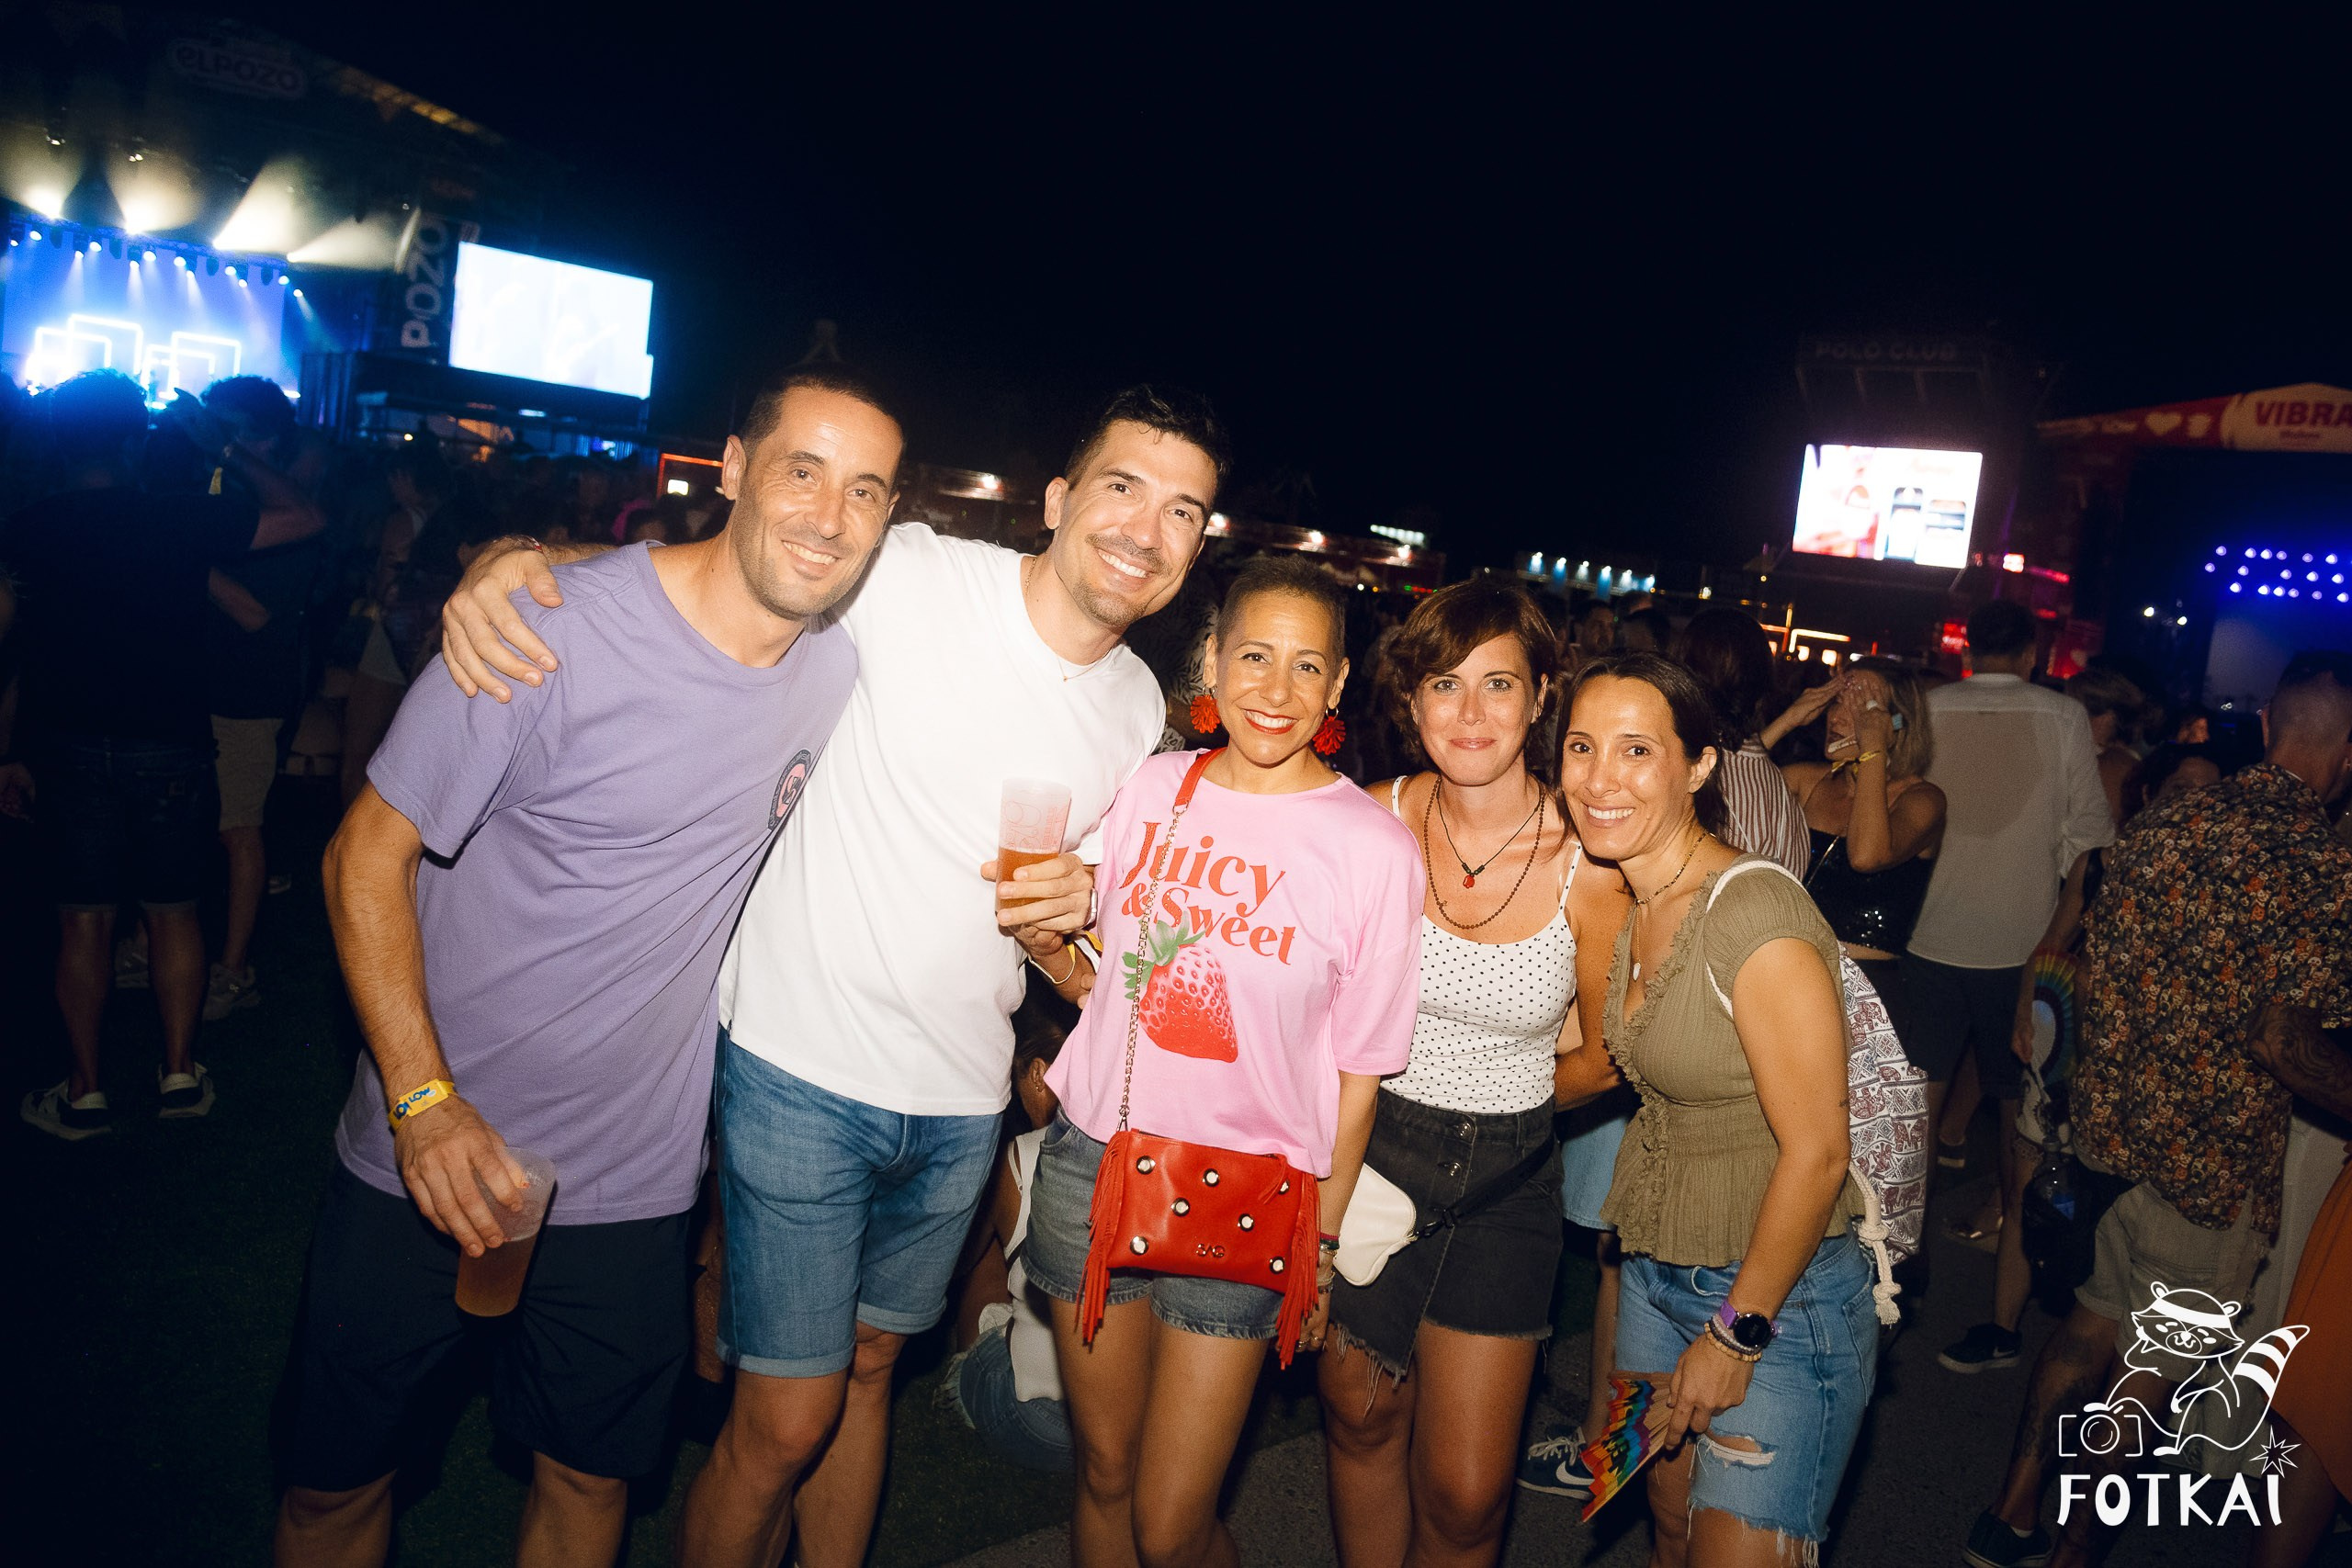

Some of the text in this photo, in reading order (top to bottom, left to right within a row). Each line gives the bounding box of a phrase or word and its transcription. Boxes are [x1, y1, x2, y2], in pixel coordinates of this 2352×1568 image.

[1815, 341, 1958, 361] POLO CLUB
[1119, 822, 1285, 918] Juicy
[1121, 883, 1296, 965] & Sweet
